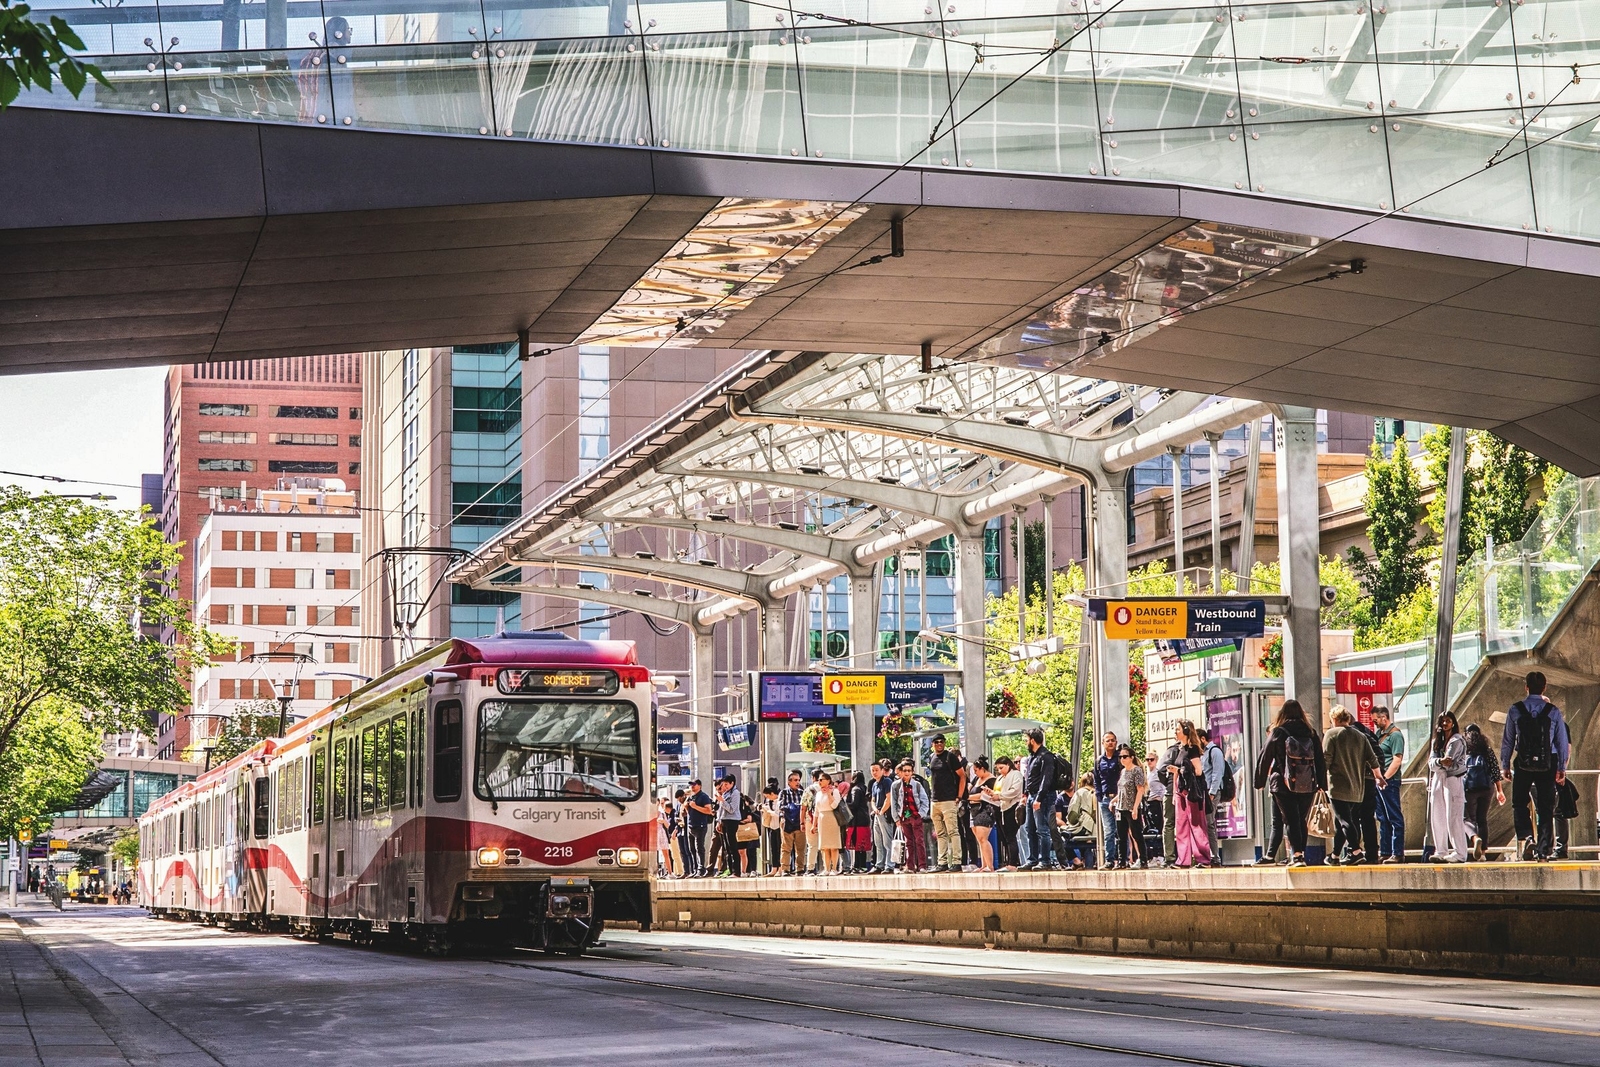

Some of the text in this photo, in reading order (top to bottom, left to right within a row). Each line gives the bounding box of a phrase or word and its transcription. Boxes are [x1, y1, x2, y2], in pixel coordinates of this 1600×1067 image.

[1136, 608, 1177, 616] DANGER
[1194, 608, 1256, 618] Westbound
[1194, 622, 1221, 632] Train
[543, 675, 591, 686] SOMERSET
[1357, 678, 1376, 687] Help
[512, 808, 606, 823] Calgary Transit
[544, 846, 573, 857] 2218
